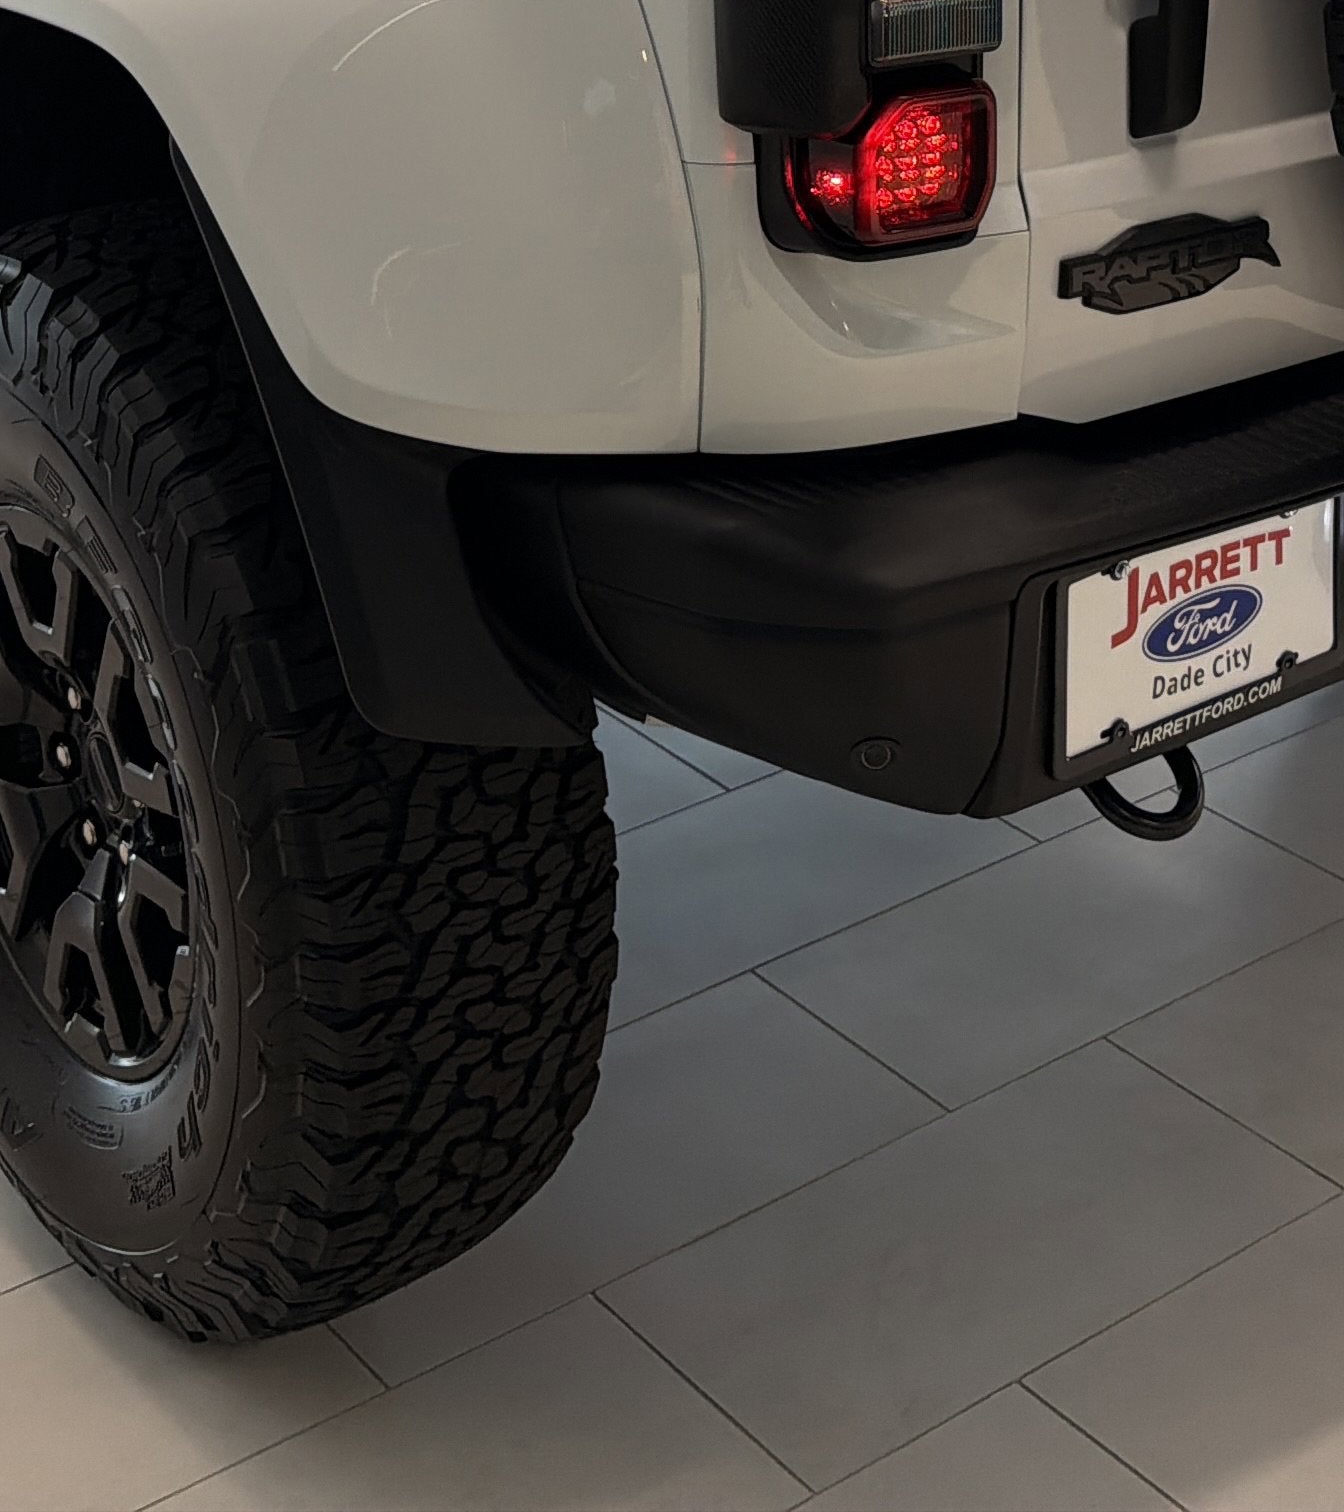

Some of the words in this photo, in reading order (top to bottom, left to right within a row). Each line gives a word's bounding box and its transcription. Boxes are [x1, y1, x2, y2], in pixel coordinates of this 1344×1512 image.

[1071, 228, 1272, 294] RAPTOR
[1110, 527, 1291, 649] JARRETT
[1166, 597, 1239, 653] Ford
[1151, 665, 1205, 700] Dade
[1212, 643, 1253, 677] City
[1130, 675, 1283, 753] JARRETTFORD.COM
